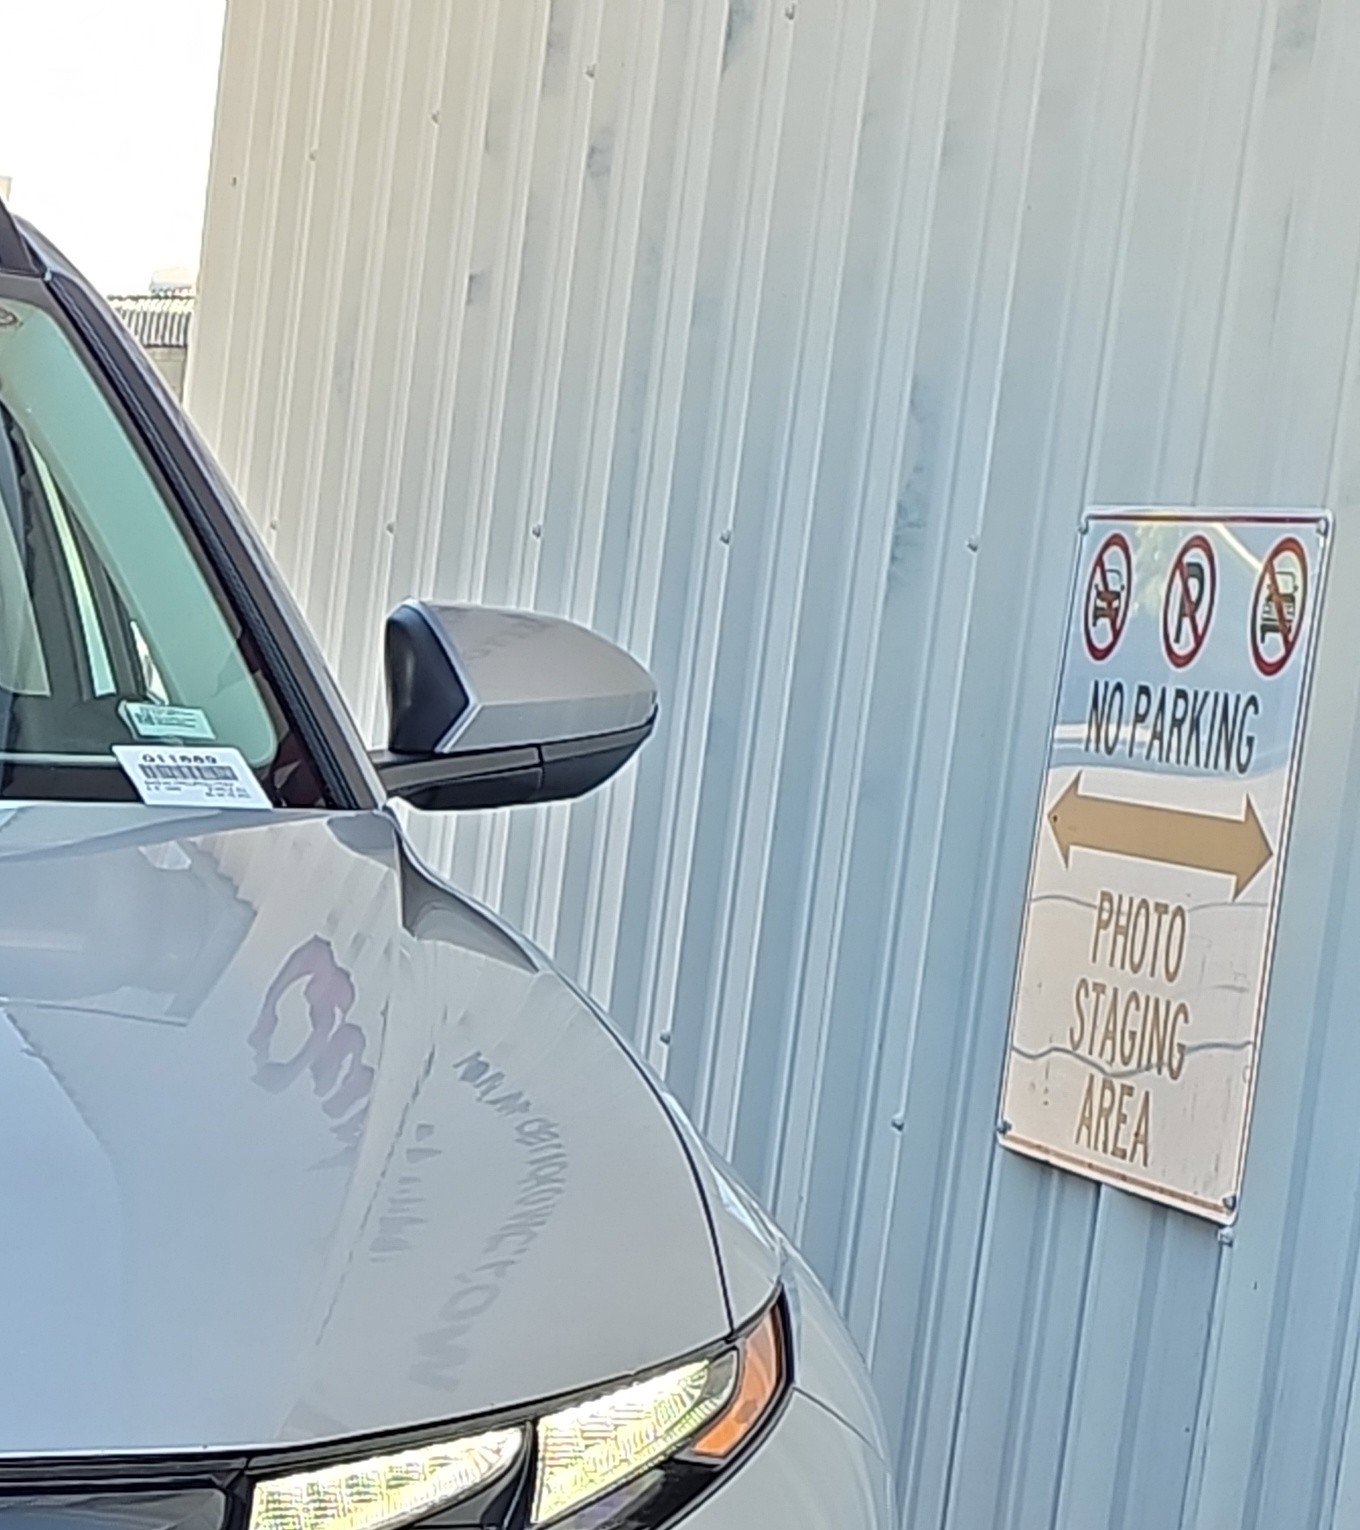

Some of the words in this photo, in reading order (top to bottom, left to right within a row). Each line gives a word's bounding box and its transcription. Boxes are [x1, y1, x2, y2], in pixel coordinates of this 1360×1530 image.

[1084, 679, 1125, 756] NO
[1128, 684, 1260, 775] PARKING
[1091, 890, 1187, 983] PHOTO
[1069, 977, 1190, 1081] STAGING
[1074, 1073, 1151, 1168] AREA
